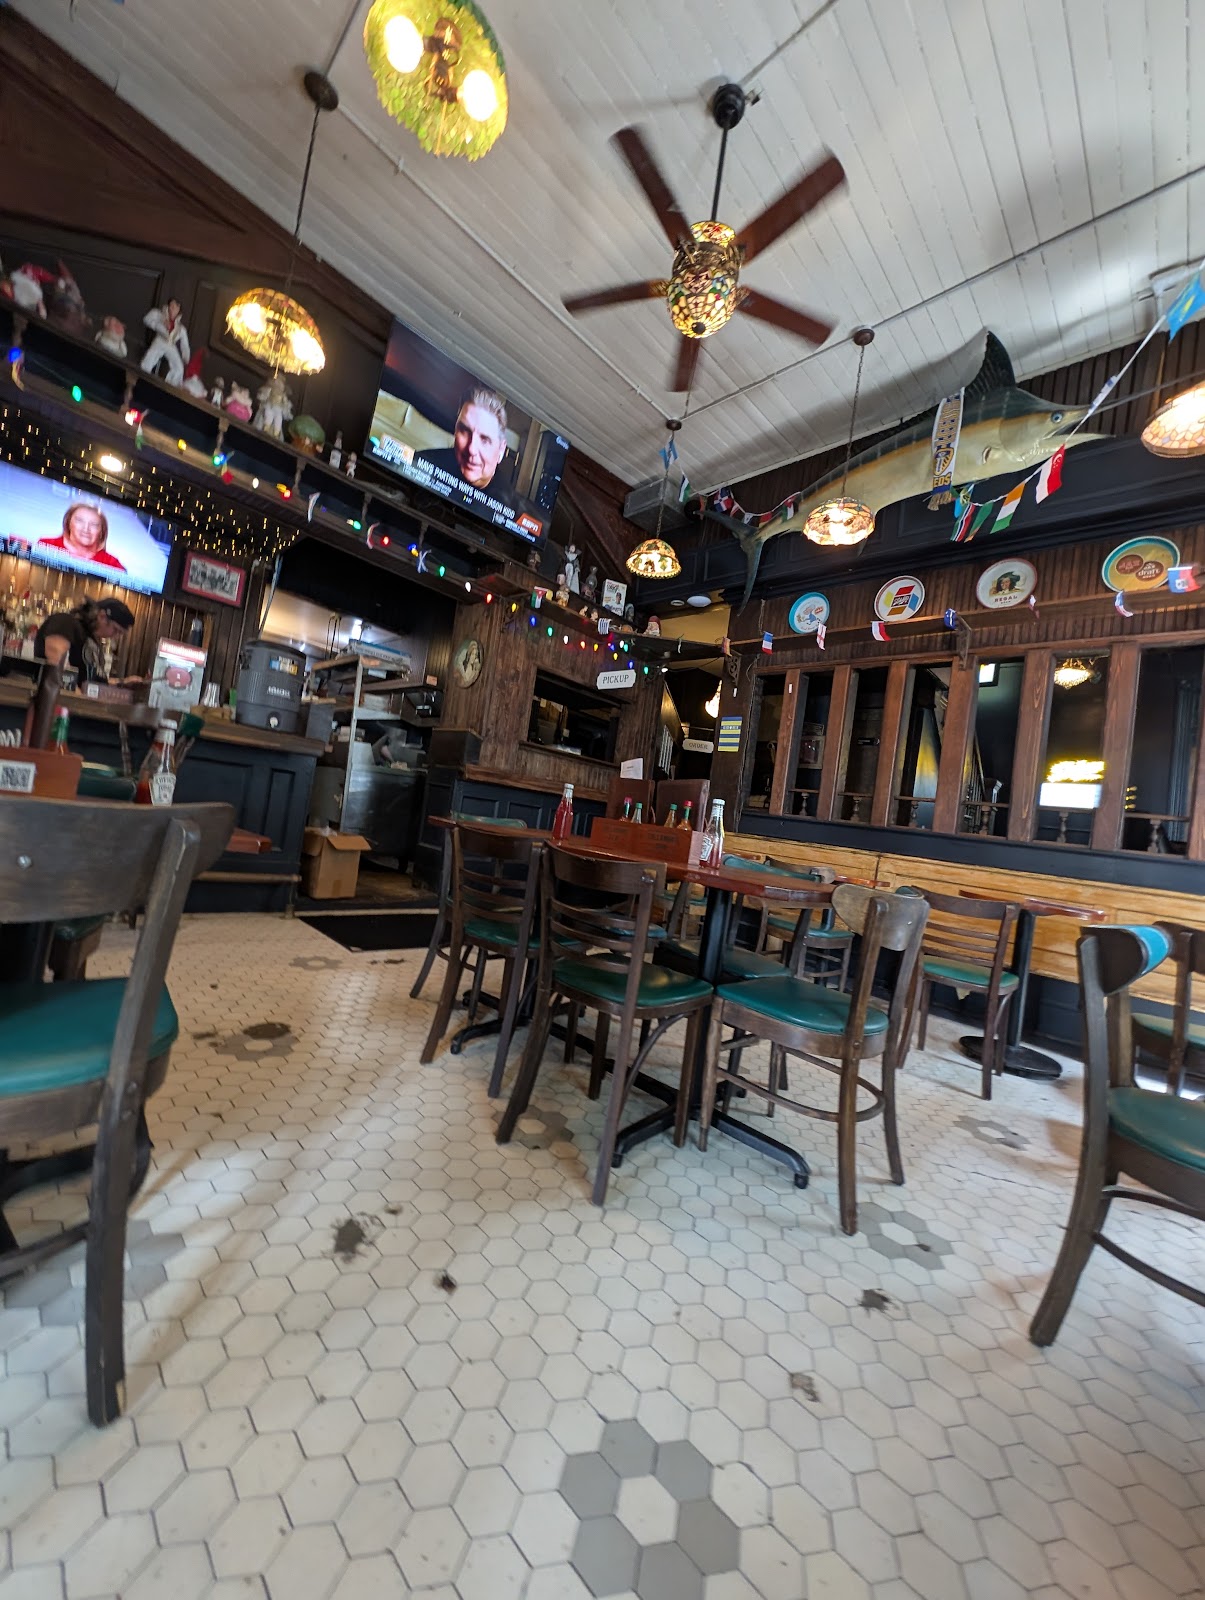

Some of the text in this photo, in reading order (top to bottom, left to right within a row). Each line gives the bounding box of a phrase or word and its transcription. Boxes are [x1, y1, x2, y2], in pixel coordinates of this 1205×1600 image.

[417, 457, 434, 475] MAVS
[434, 466, 459, 488] PARTING
[458, 480, 474, 497] WAYS
[473, 489, 488, 504] WITH
[487, 497, 503, 513] JASON
[1138, 567, 1160, 576] draft
[603, 675, 629, 684] PICKUP
